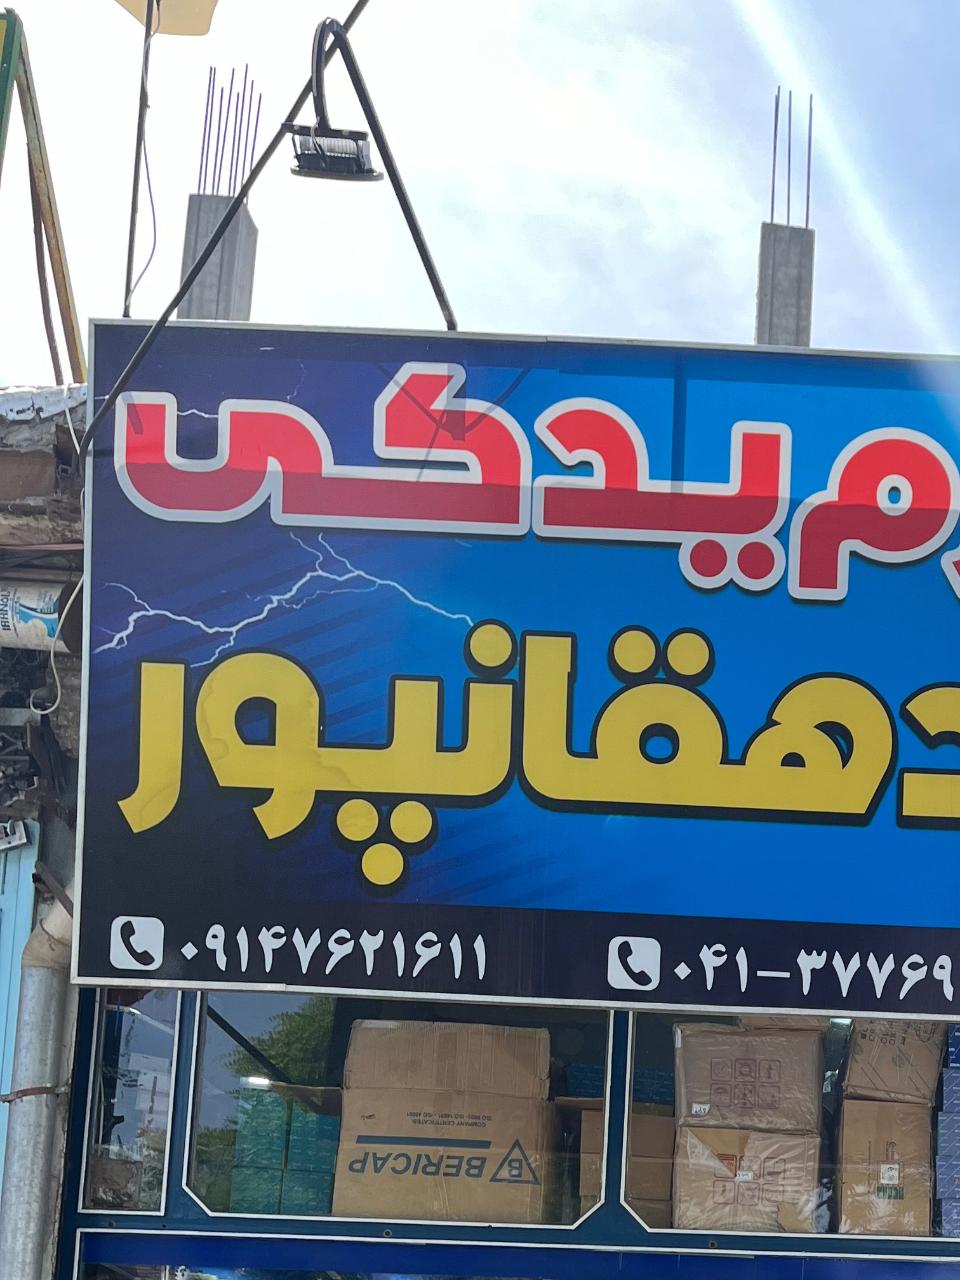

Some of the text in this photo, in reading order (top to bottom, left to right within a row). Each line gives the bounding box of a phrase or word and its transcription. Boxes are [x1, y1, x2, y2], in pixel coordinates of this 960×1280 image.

[115, 363, 792, 589] یدکی
[181, 924, 487, 984] ۰۹۱۴۷۶۲۱۶۱۱
[348, 1152, 523, 1178] B BERICAP
